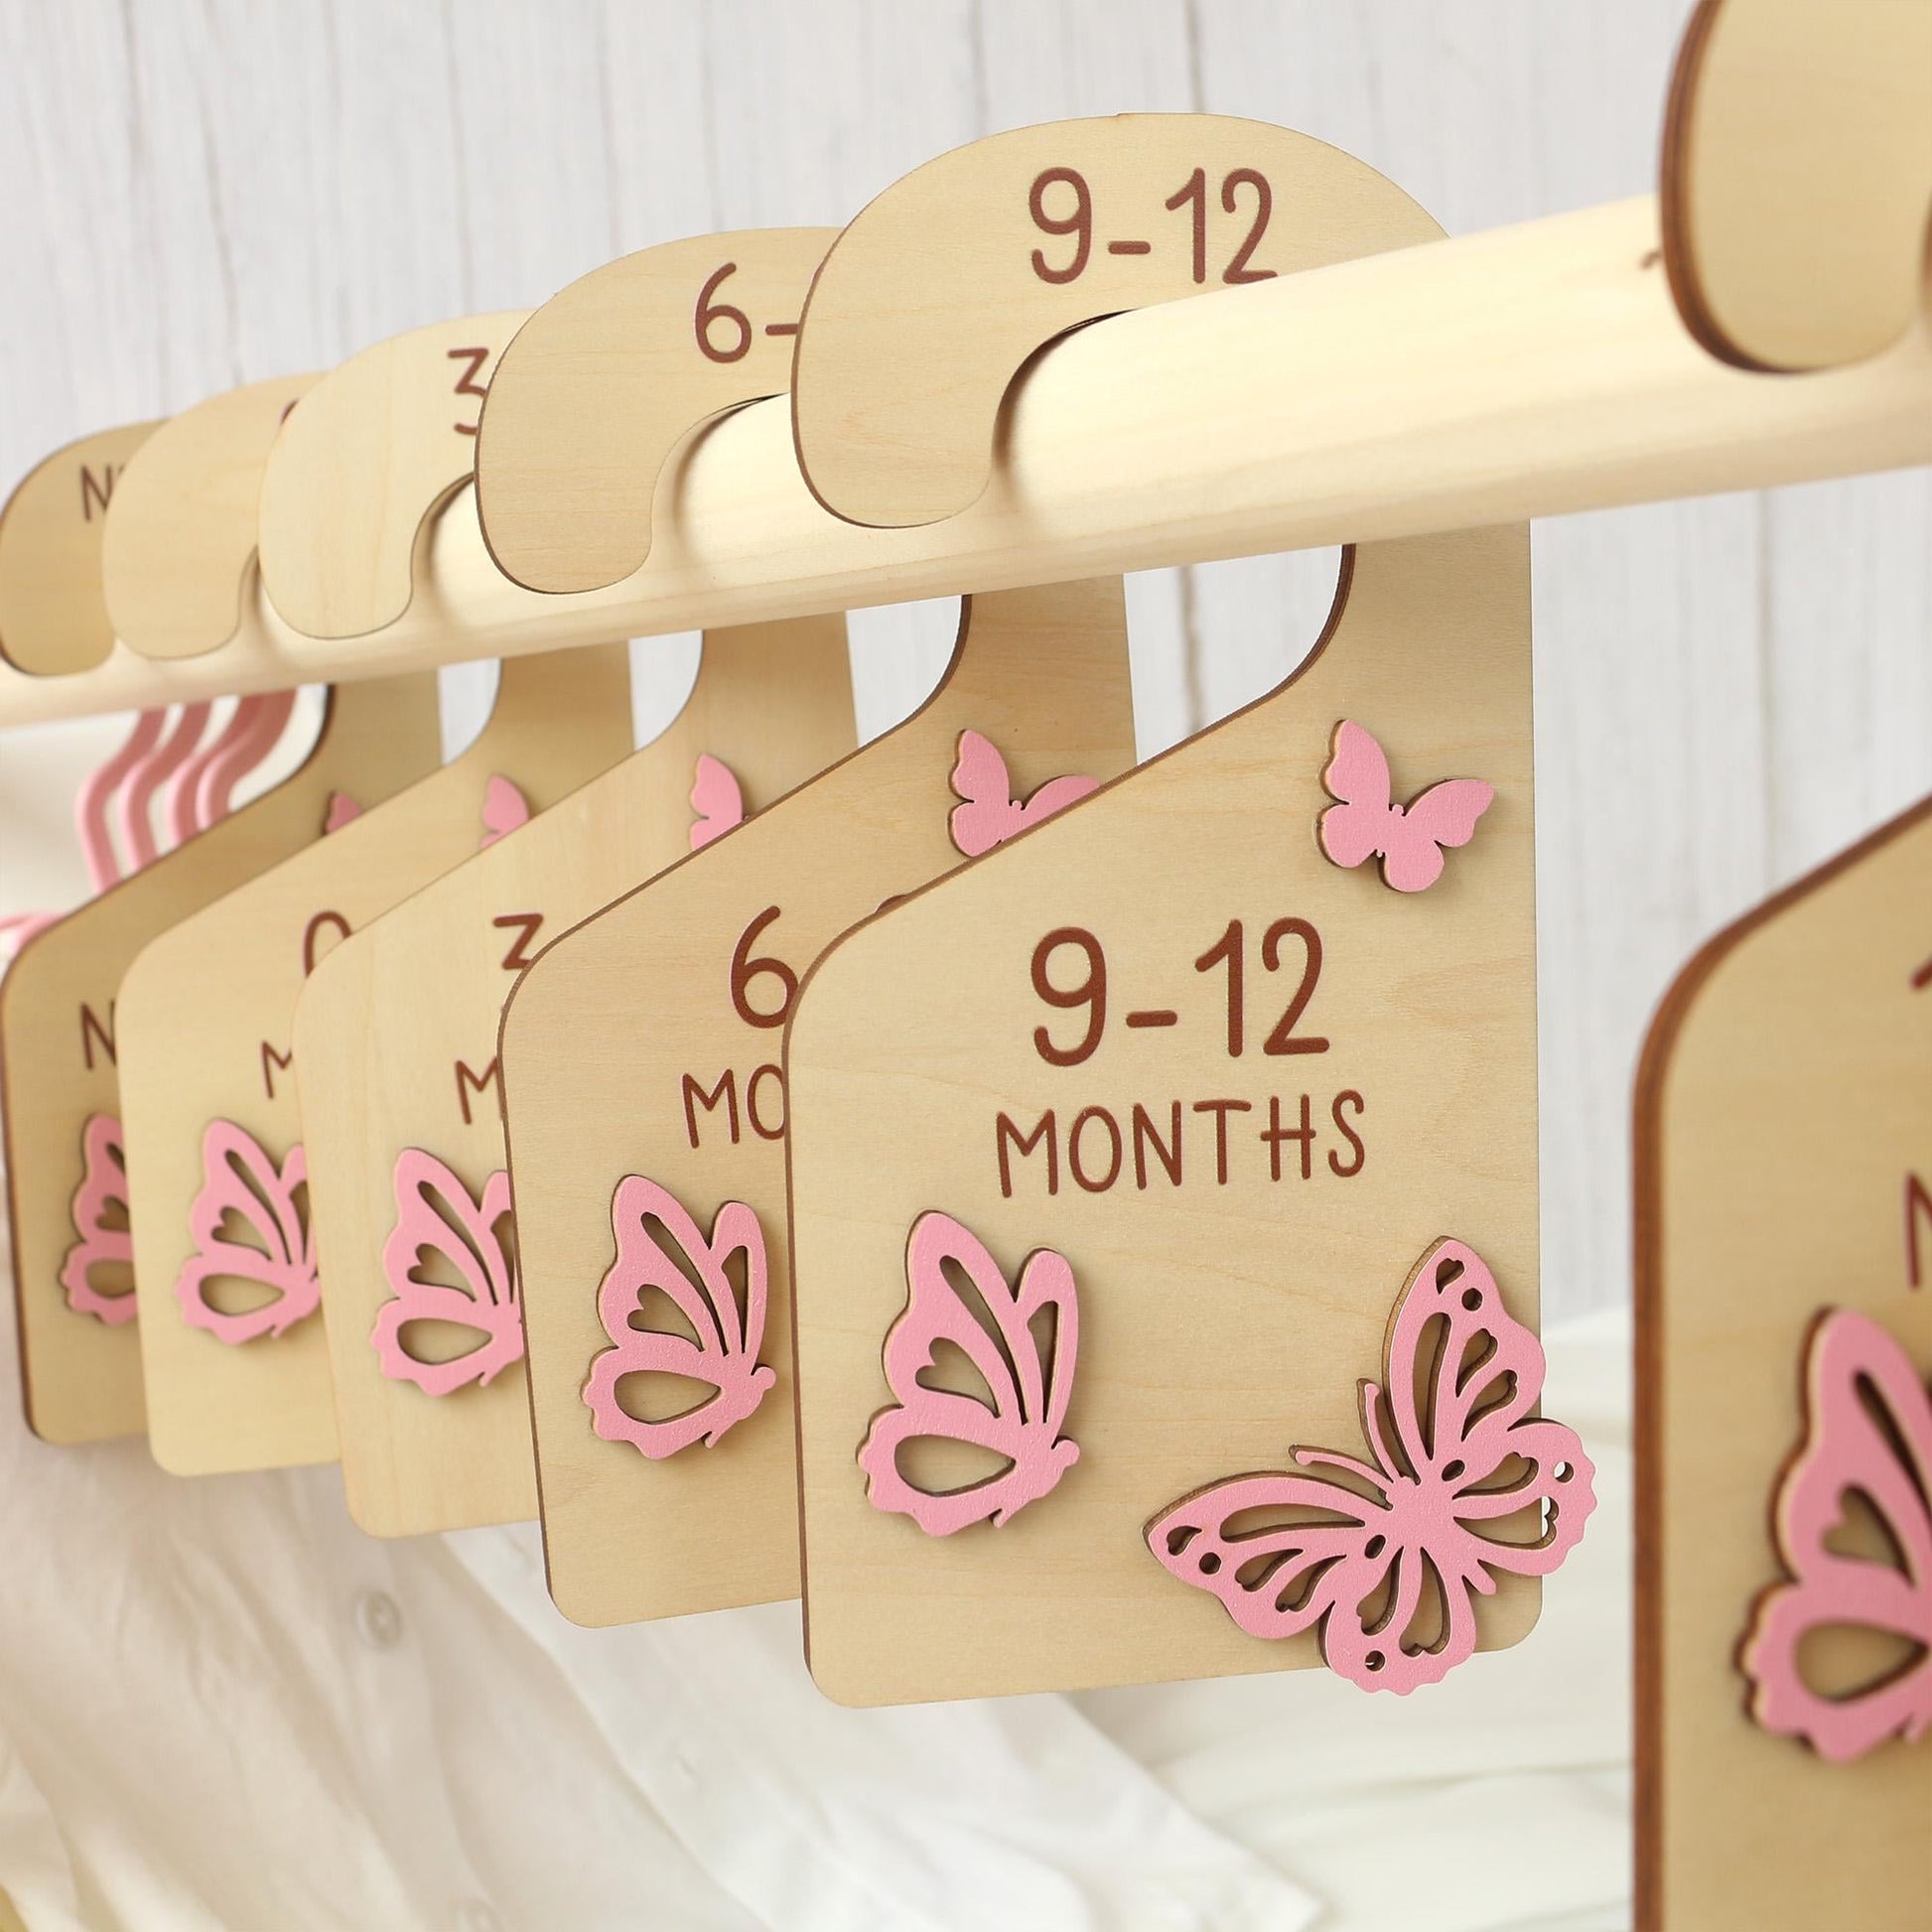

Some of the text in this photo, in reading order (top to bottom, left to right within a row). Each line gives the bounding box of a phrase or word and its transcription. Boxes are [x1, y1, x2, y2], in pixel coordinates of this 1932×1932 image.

[1029, 167, 1278, 285] 9-12
[1031, 916, 1330, 1067] 9-12
[996, 1089, 1365, 1198] MONTHS
